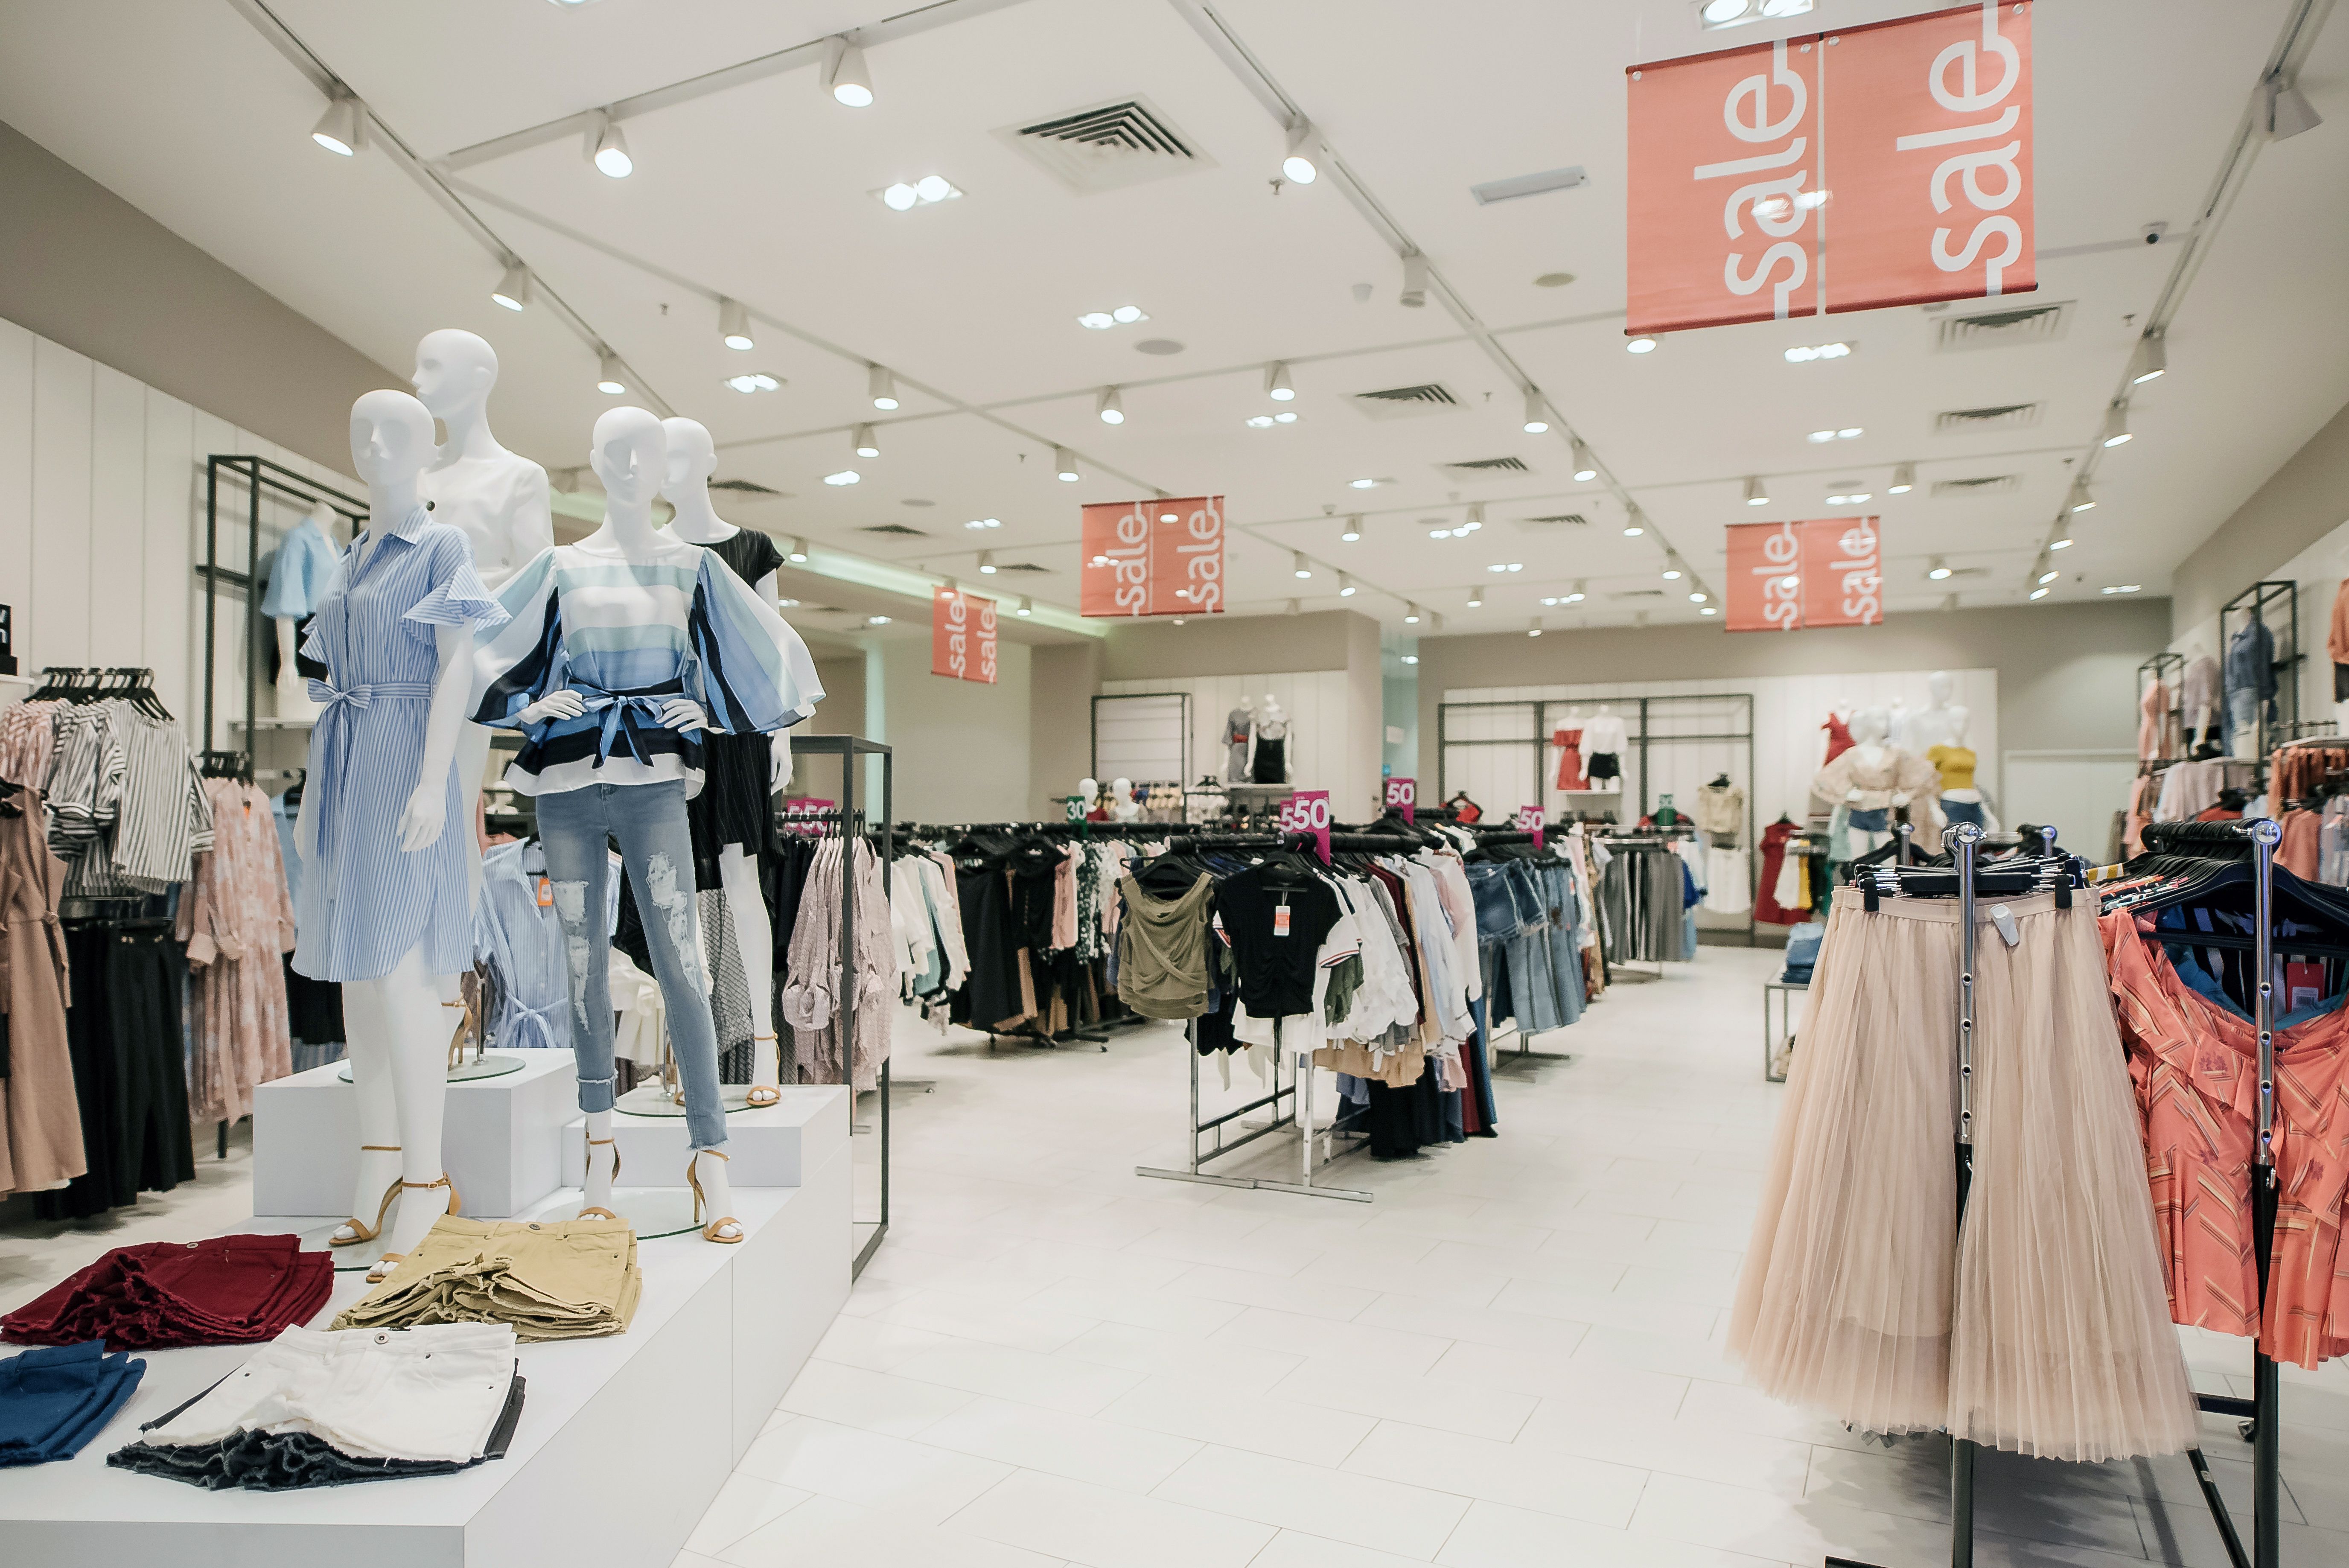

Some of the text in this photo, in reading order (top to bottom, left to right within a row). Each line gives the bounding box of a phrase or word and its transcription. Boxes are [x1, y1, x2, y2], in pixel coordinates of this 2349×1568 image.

[1694, 39, 1807, 319] sale
[1896, 0, 2023, 296] sale
[1105, 501, 1148, 615] sale
[1176, 497, 1221, 612] sale
[1752, 522, 1798, 630] sale
[1829, 517, 1878, 625] sale
[944, 592, 966, 678] sale
[977, 601, 996, 683] sale
[1067, 801, 1087, 819] 30
[1294, 798, 1329, 830] 50
[1386, 783, 1414, 804] 50
[1516, 810, 1545, 831] 50
